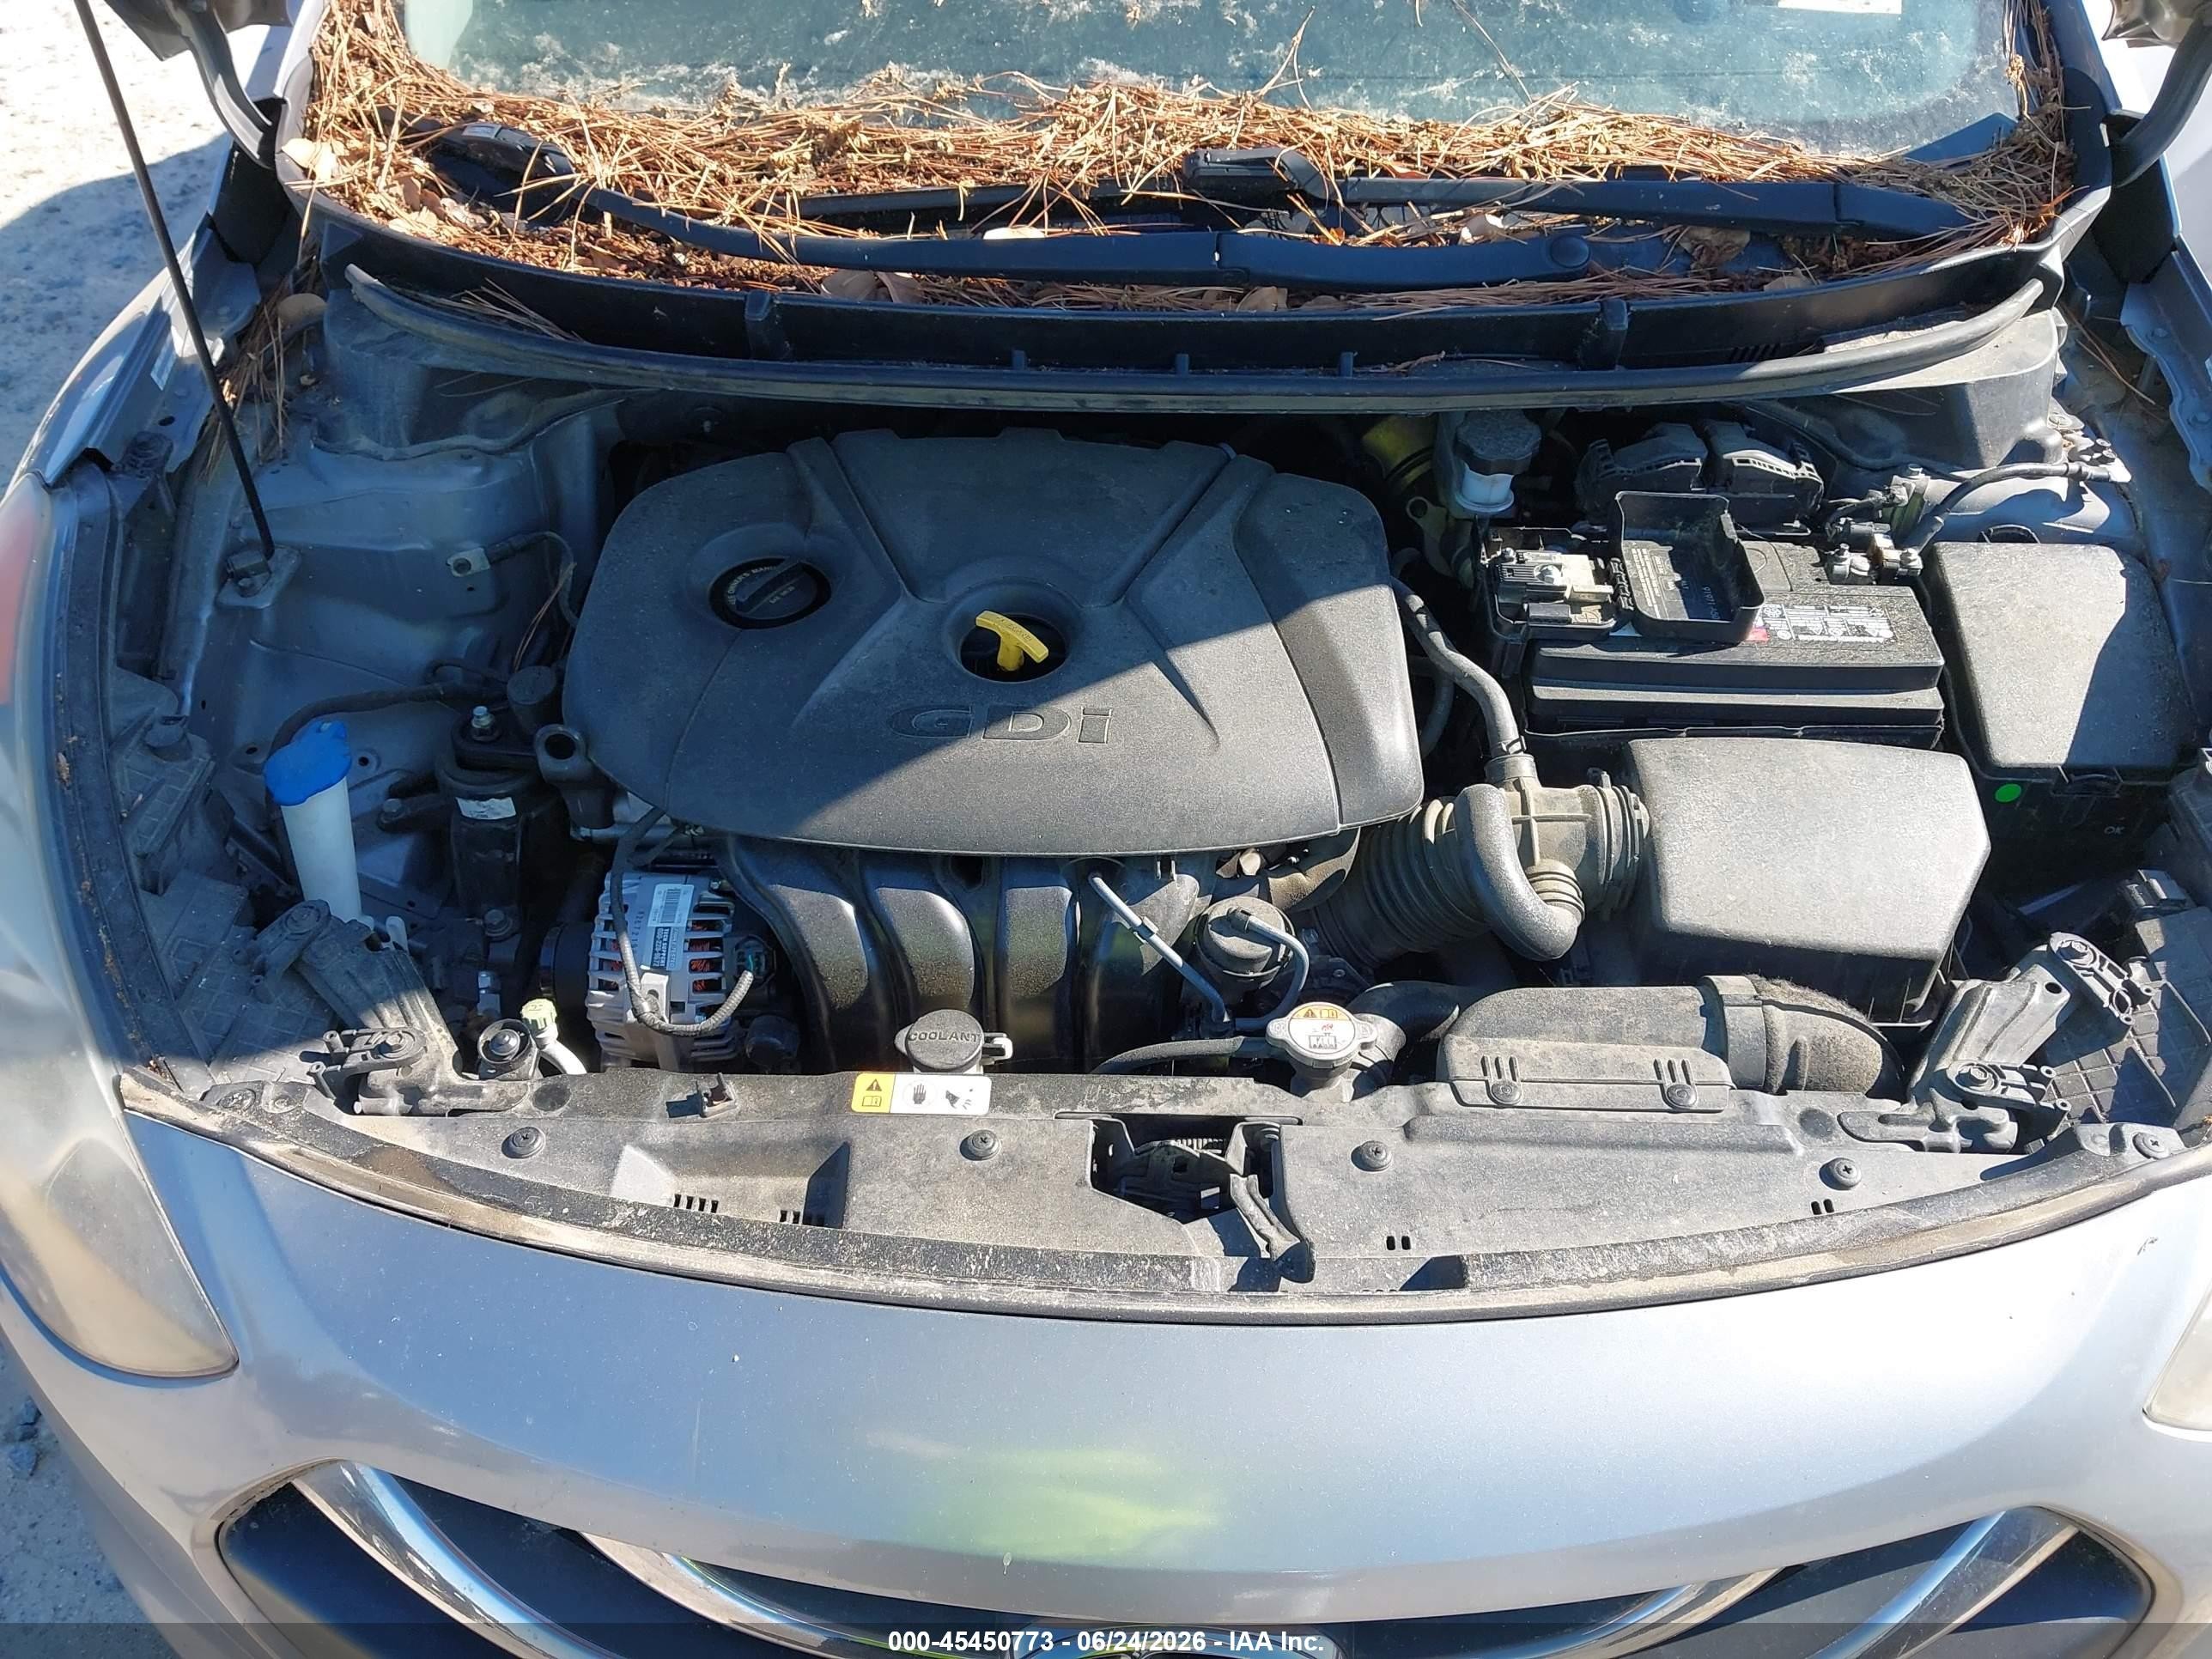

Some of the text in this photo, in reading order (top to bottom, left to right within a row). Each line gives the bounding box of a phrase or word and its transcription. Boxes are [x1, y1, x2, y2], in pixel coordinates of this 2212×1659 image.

[887, 705, 1114, 744] GDi
[2103, 825, 2125, 836] OK
[659, 942, 668, 967] SUPPORT
[908, 1031, 980, 1043] COOLANT
